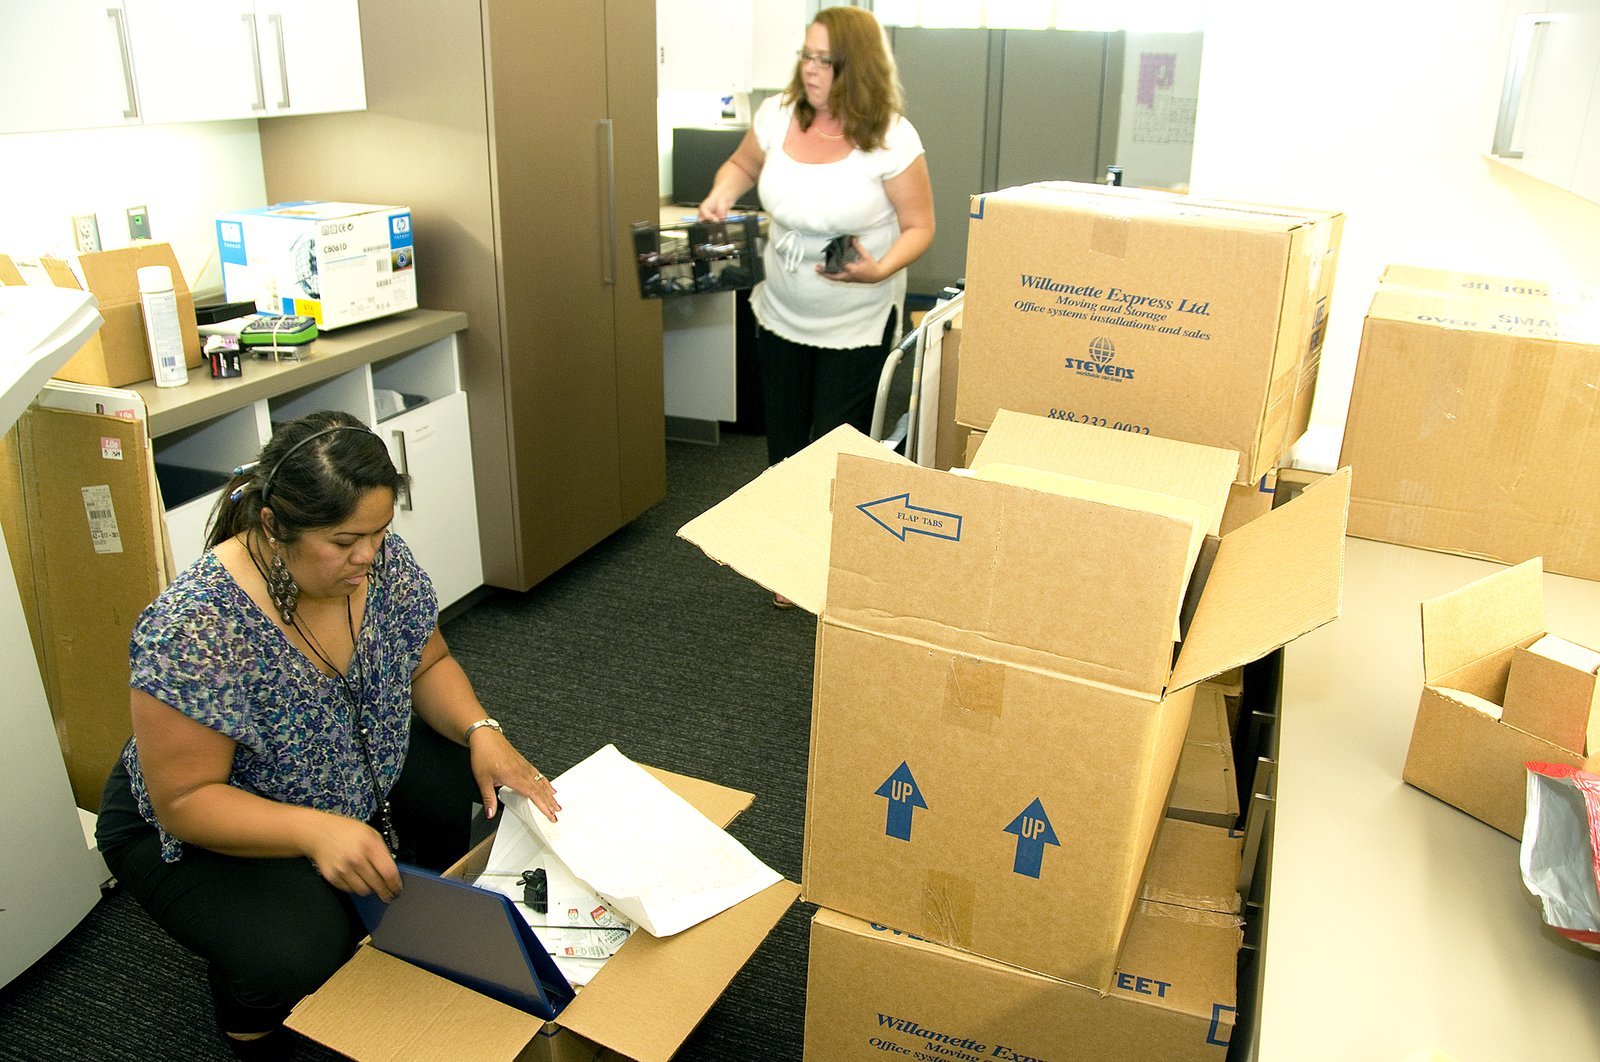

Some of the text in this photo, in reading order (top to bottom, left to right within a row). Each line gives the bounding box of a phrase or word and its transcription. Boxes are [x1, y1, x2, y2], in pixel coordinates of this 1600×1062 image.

[1020, 273, 1211, 316] Willamette Express Ltd.
[1014, 300, 1212, 341] Office systems installations and sales
[1055, 295, 1168, 322] Moving and Storage
[1064, 357, 1135, 379] STEVENS
[896, 512, 943, 528] FLAP TABS
[891, 779, 913, 803] UP
[1021, 815, 1046, 840] UP
[1114, 971, 1172, 998] EET
[876, 1012, 987, 1053] Willamette
[868, 1037, 911, 1057] Office
[924, 1042, 980, 1062] Moving
